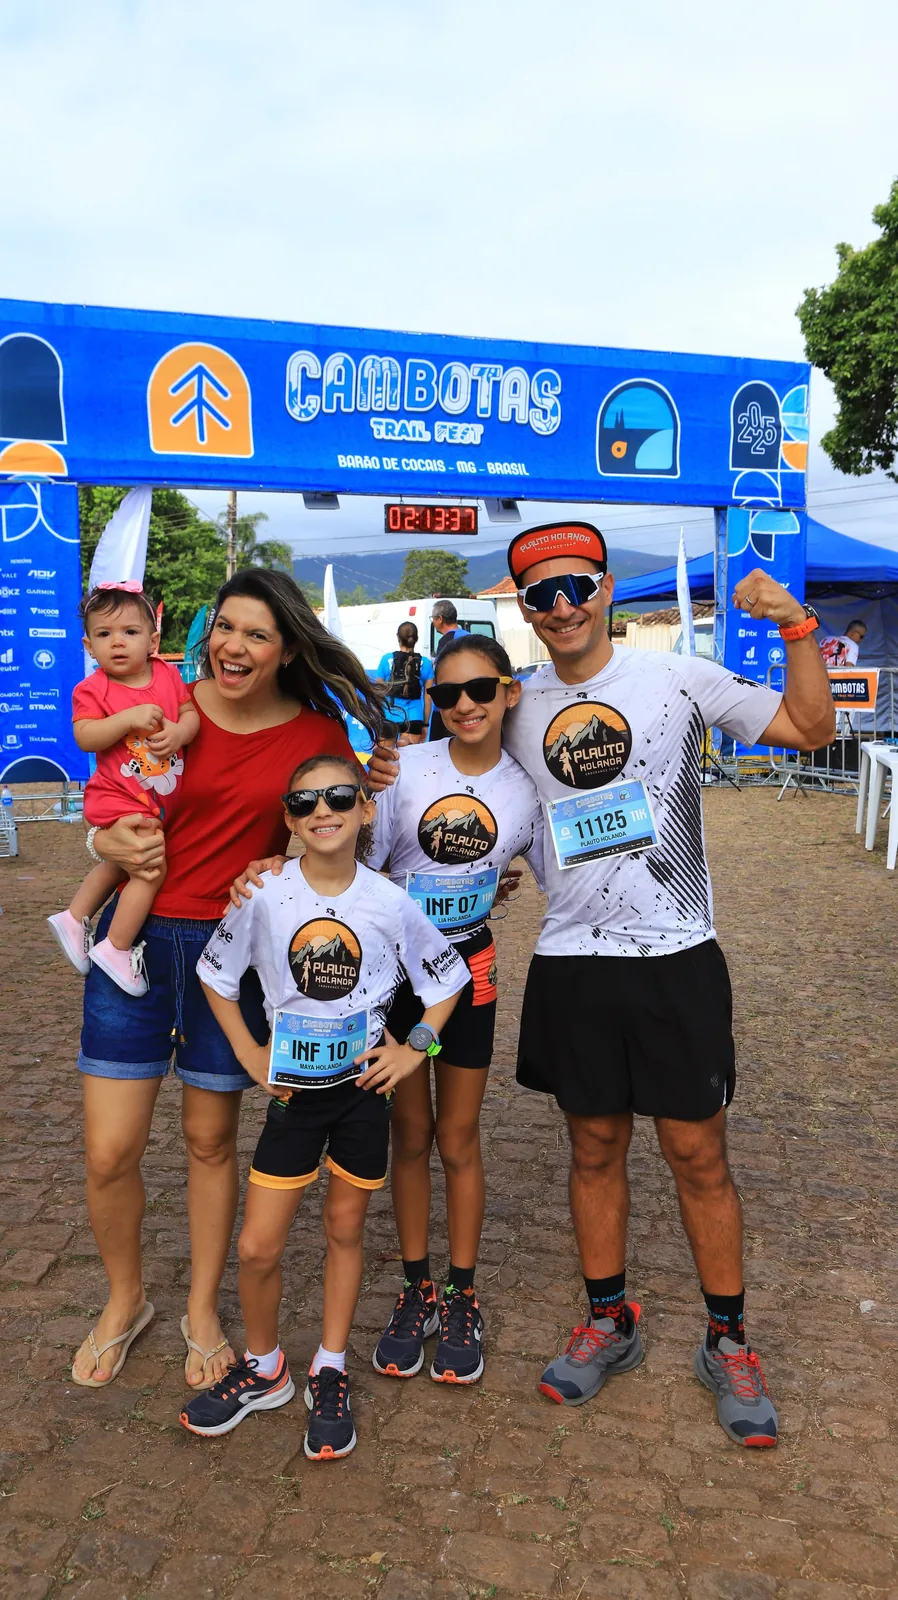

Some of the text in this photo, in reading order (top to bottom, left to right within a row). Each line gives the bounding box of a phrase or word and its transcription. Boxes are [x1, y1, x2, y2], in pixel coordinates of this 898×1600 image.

[285, 350, 561, 435] CAMBOTAS
[370, 417, 484, 444] TRAIL FEST
[338, 454, 380, 469] BARÃO
[382, 457, 400, 470] DE
[402, 458, 446, 472] COCAIS
[456, 460, 476, 473] MG
[487, 462, 530, 476] BRASIL
[390, 506, 474, 530] 02:13:37
[520, 532, 592, 552] PLAUTO HOLANDA
[830, 682, 866, 694] AMBOTAS
[573, 742, 625, 764] PLAUTO
[580, 756, 622, 772] HOLANDA
[575, 810, 628, 839] 11125
[444, 833, 489, 851] PLAUTO
[580, 838, 600, 847] PLAUTO
[601, 831, 626, 842] HOLANDA
[446, 846, 480, 858] HOLANDA
[426, 897, 454, 916] INF
[458, 894, 478, 914] 07
[448, 914, 472, 922] HOLANDA
[312, 962, 356, 978] PLAUTO
[315, 976, 353, 986] HOLANDA
[292, 1040, 320, 1062] INF
[327, 1041, 348, 1062] 10
[316, 1062, 342, 1071] HOLANDA
